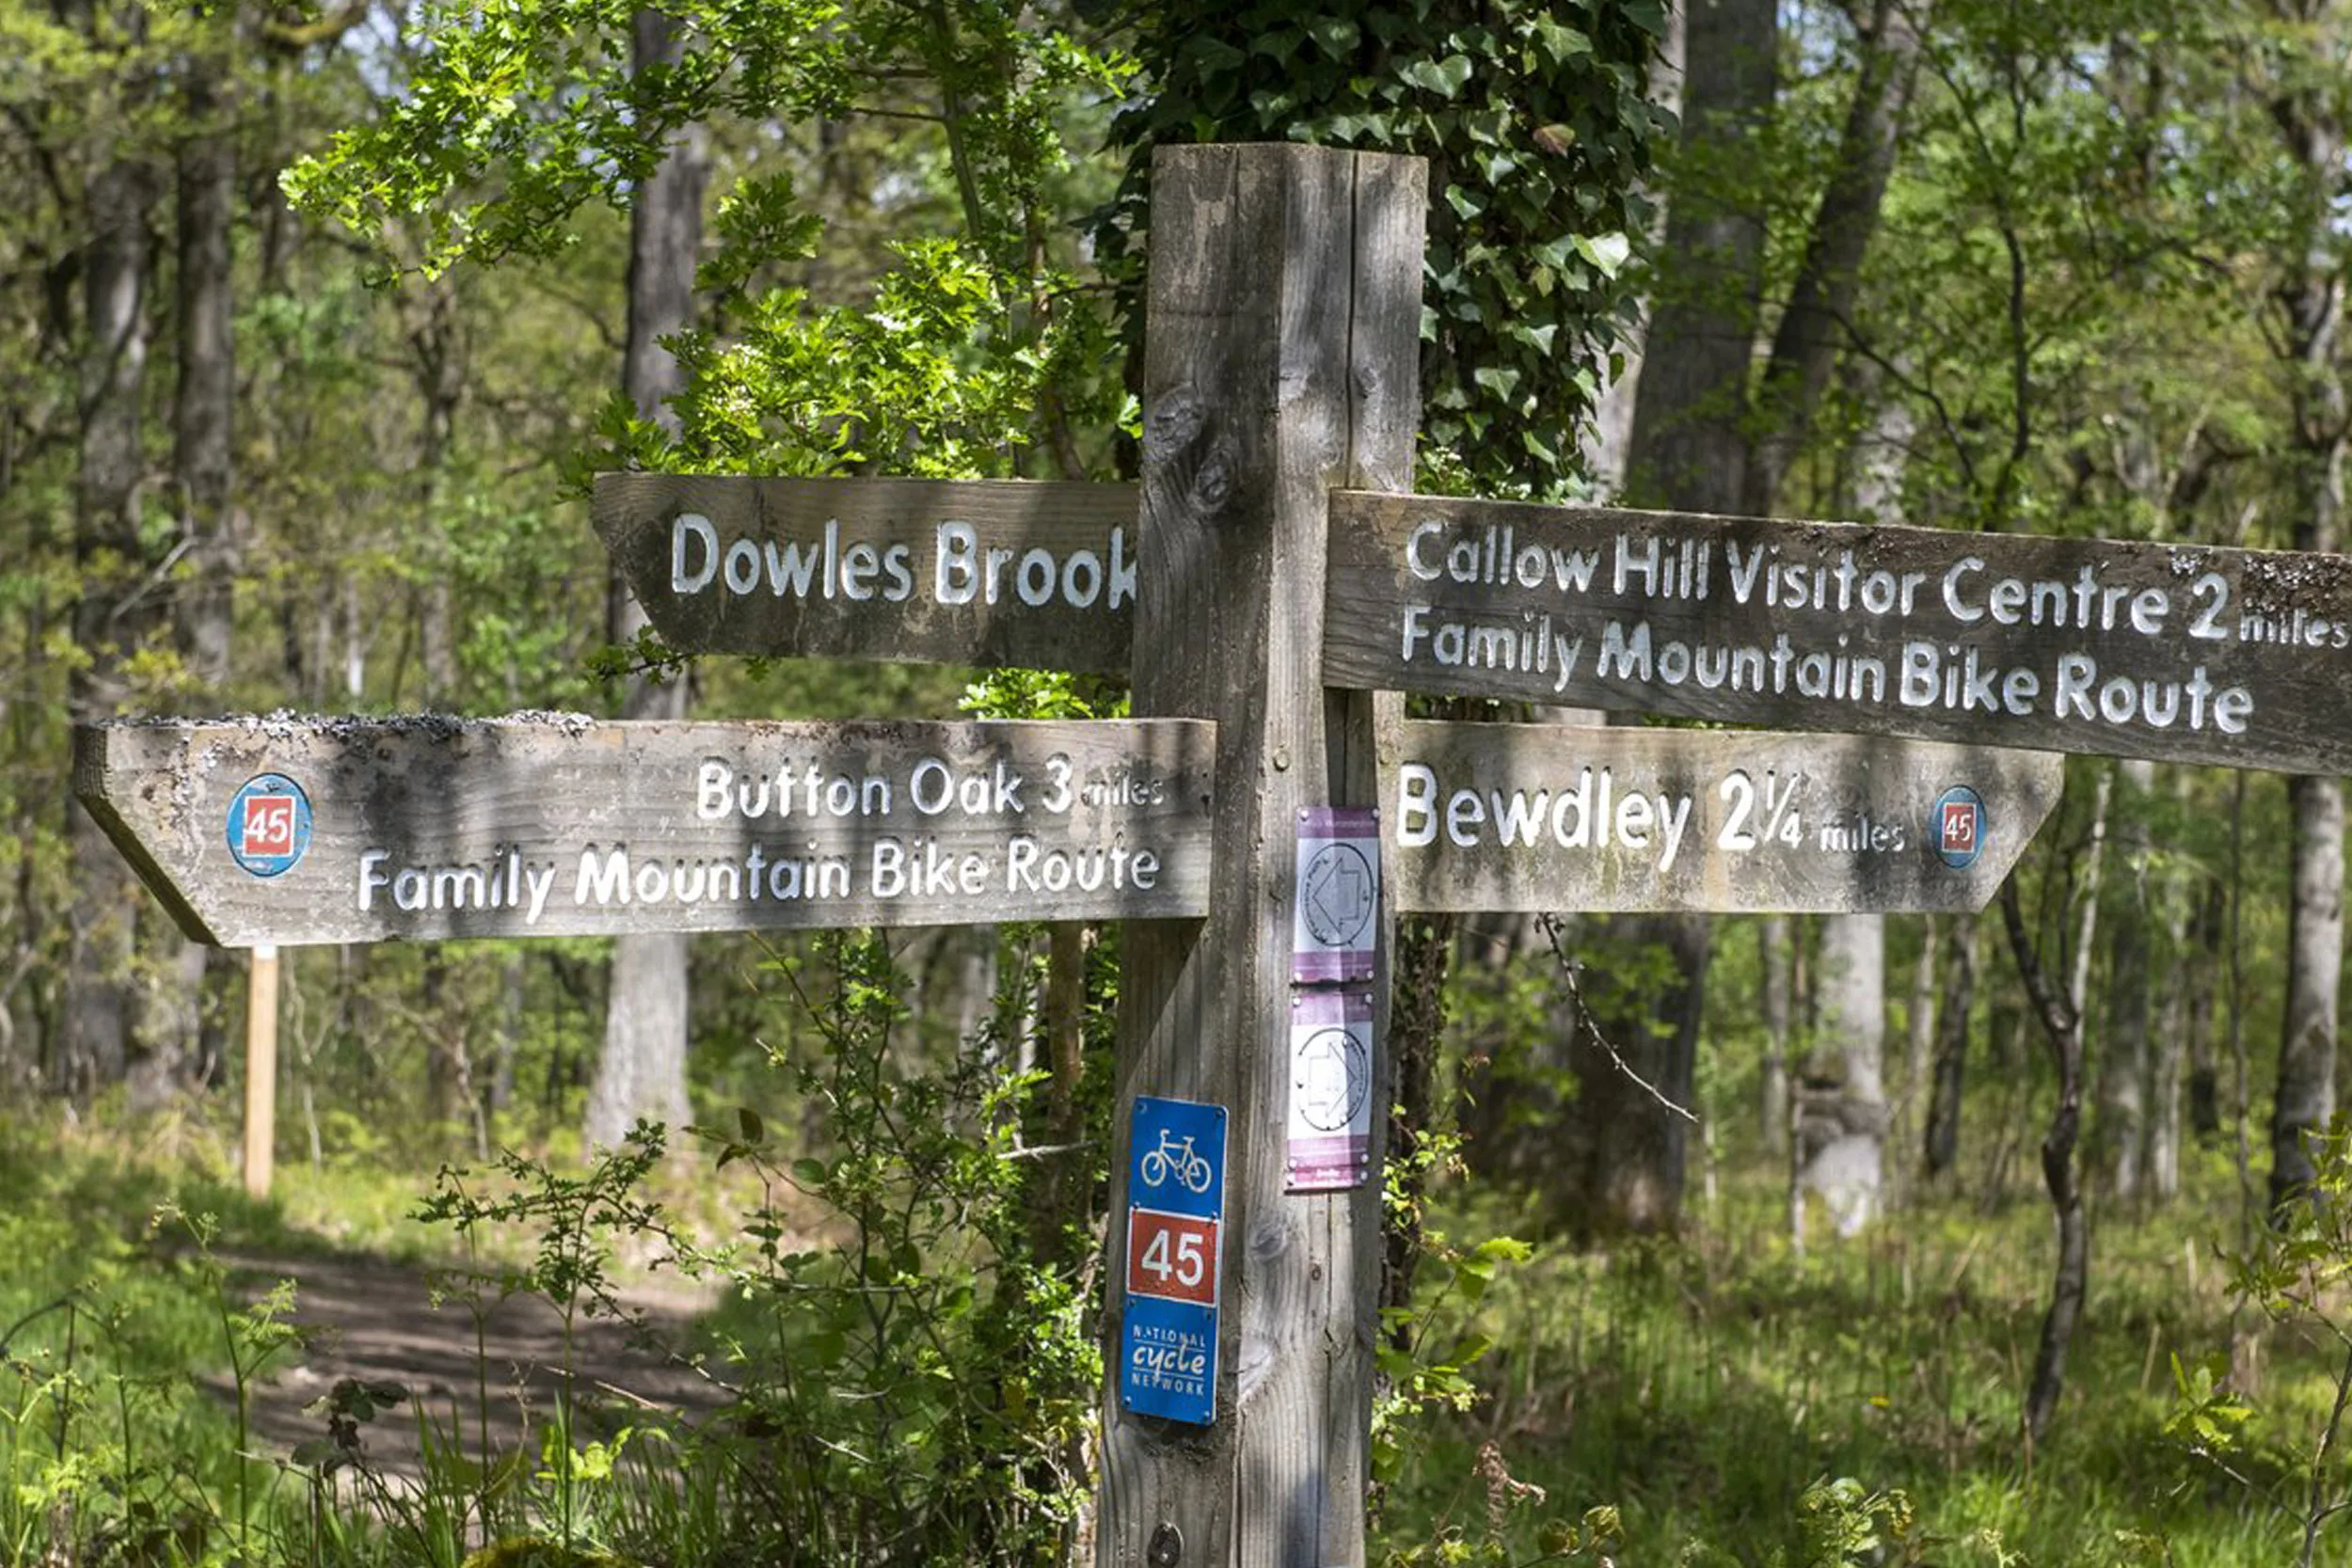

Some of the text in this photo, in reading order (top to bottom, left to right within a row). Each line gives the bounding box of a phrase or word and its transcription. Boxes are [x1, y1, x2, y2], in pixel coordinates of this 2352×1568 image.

[671, 514, 1137, 610] Dowles Brook
[1406, 521, 2350, 650] Callow Hill Visitor Centre 2 miles
[1403, 605, 2254, 735] Family Mountain Bike Route
[696, 752, 1165, 820] Button Oak 3 miles
[1396, 763, 1692, 872] Bewdley
[1820, 815, 1906, 852] miles
[245, 807, 289, 844] 45
[1944, 811, 1973, 844] 45
[358, 831, 1160, 927] Family Mountain Bike Route
[1140, 1228, 1204, 1288] 45
[1132, 1323, 1207, 1348] NATIONAL
[1133, 1342, 1207, 1381] cycle
[1131, 1371, 1205, 1397] NETWORK
